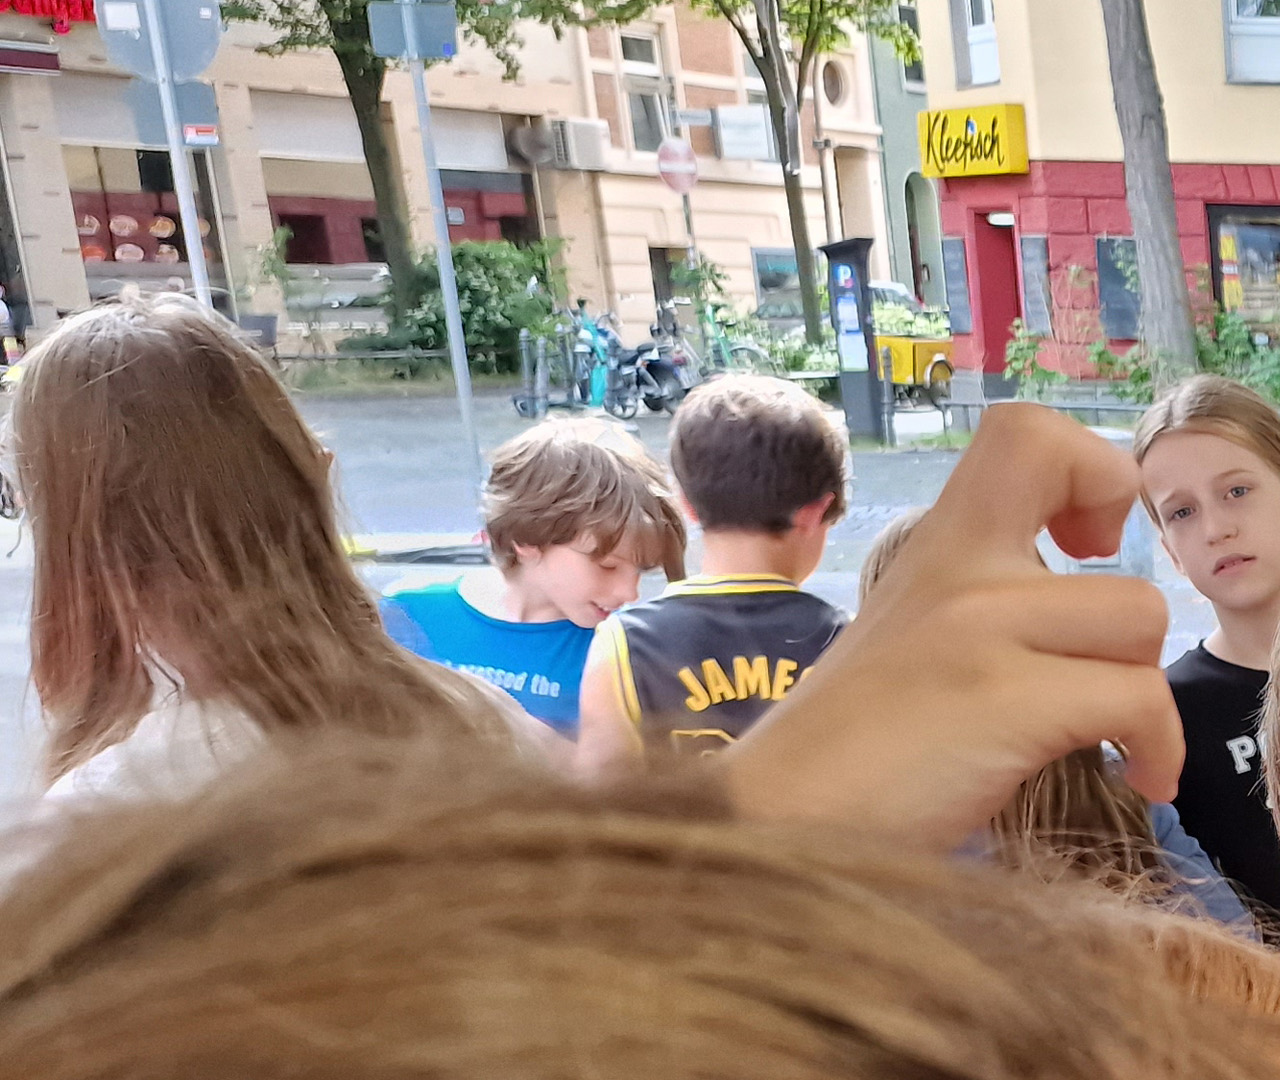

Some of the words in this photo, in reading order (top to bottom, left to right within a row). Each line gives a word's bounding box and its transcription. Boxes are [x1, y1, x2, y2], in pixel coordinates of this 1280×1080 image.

[926, 111, 1005, 174] Kleefisch
[530, 673, 561, 698] the
[678, 654, 816, 712] JAME
